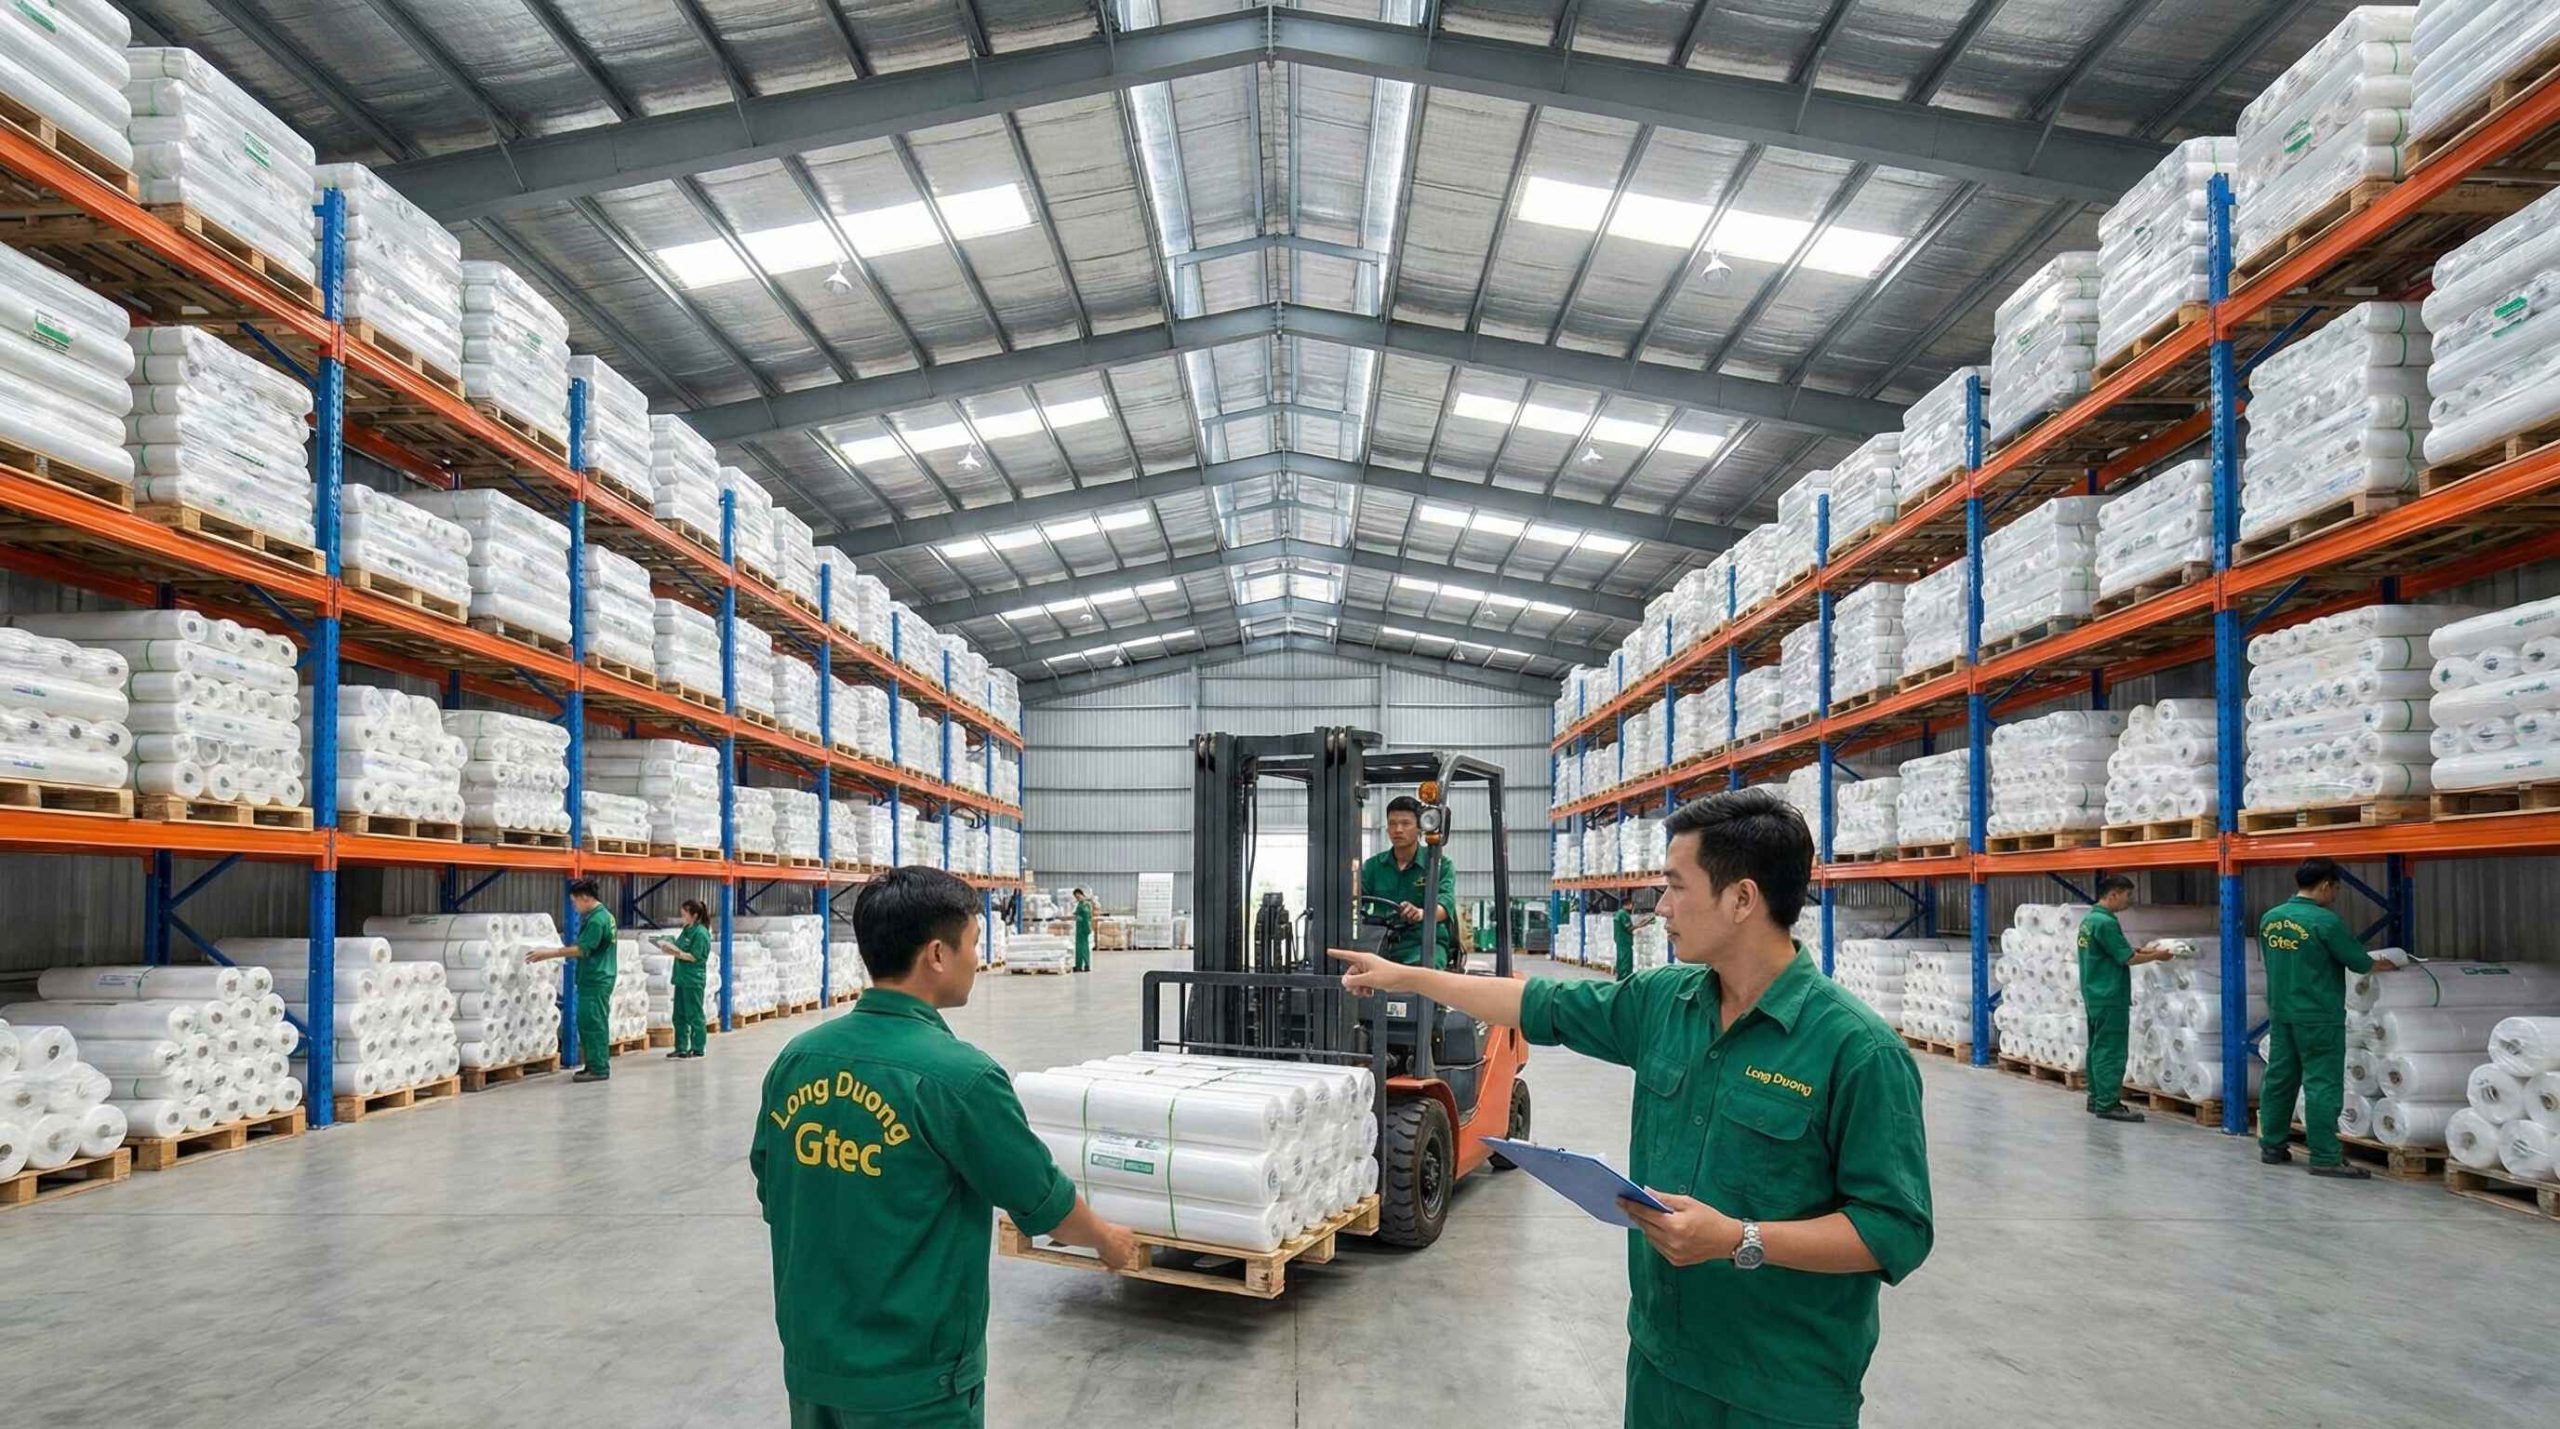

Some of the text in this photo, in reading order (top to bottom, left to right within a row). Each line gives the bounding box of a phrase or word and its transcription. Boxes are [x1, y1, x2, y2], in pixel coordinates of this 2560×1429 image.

[770, 1071, 911, 1146] Long Duong
[1745, 1065, 1812, 1097] Long Duong
[795, 1122, 882, 1177] Gtec
